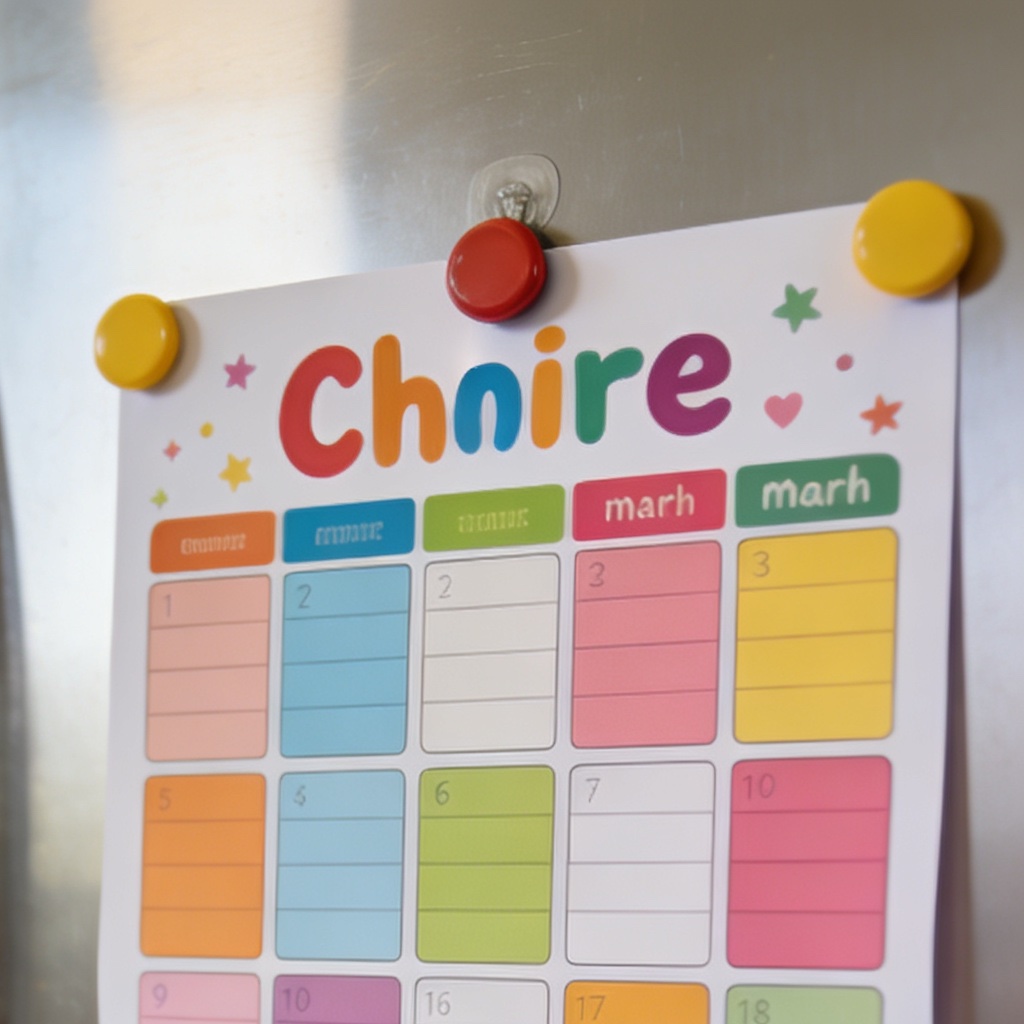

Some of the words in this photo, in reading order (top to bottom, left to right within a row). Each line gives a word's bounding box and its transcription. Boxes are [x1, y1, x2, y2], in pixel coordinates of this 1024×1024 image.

[762, 464, 871, 510] marh
[605, 484, 695, 522] marh
[588, 562, 605, 587] 3
[752, 551, 770, 578] 3
[296, 583, 312, 610] 2
[438, 574, 453, 599] 2
[435, 780, 450, 806] 6
[585, 777, 601, 803] 7
[742, 773, 775, 799] 10
[152, 983, 168, 1009] 9
[281, 986, 311, 1013] 10
[425, 991, 451, 1017] 16
[576, 995, 606, 1021] 17
